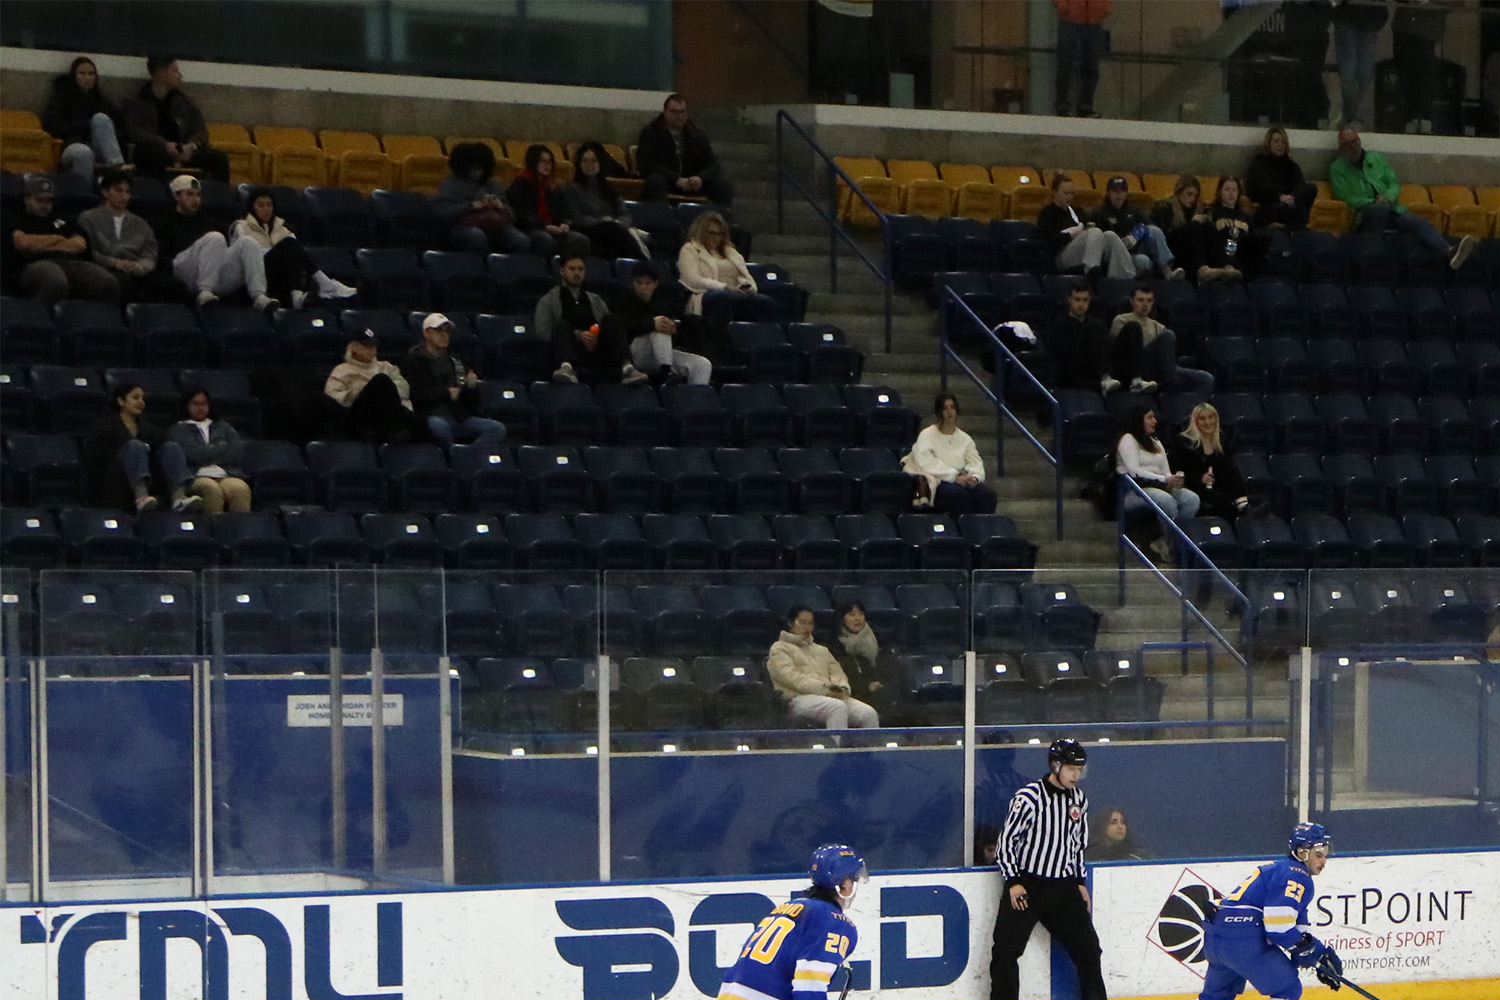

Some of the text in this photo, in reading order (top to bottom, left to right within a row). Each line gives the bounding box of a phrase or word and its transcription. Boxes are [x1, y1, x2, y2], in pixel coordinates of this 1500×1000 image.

[1284, 879, 1306, 904] 23
[1224, 915, 1255, 923] CCM
[1304, 887, 1473, 926] STPOINT
[741, 916, 797, 965] 20
[824, 932, 851, 960] 20
[1324, 930, 1446, 953] usiness of SPORT
